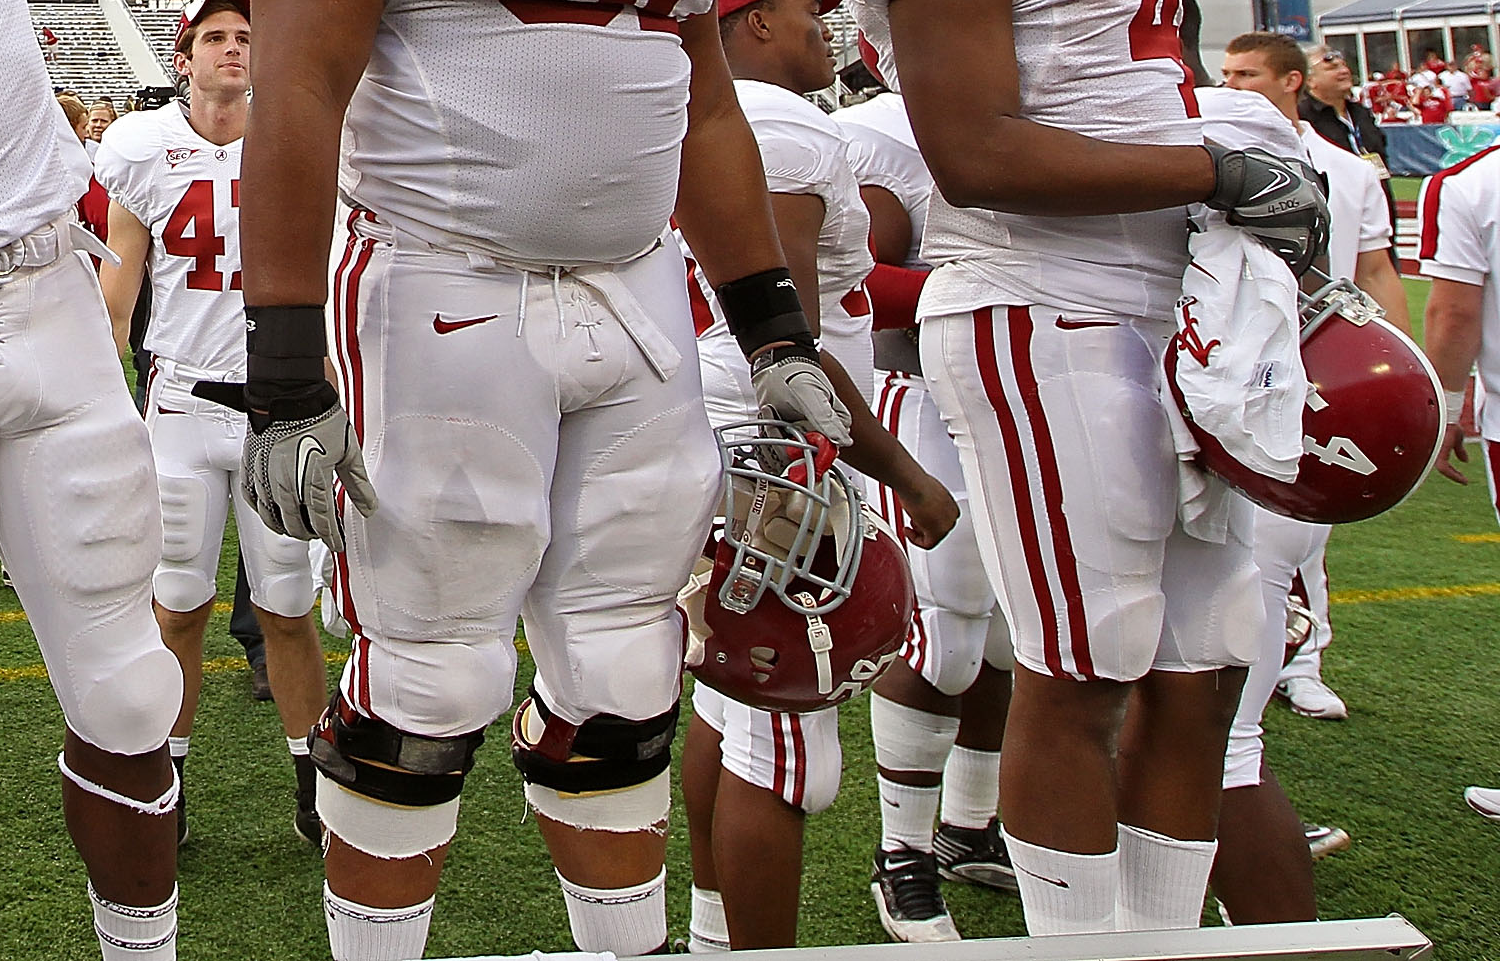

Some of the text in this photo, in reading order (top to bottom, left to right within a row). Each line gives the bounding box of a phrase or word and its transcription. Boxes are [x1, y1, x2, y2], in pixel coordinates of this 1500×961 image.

[168, 153, 188, 162] SEC
[1267, 199, 1300, 214] 4-DOG
[751, 494, 766, 516] TIDE
